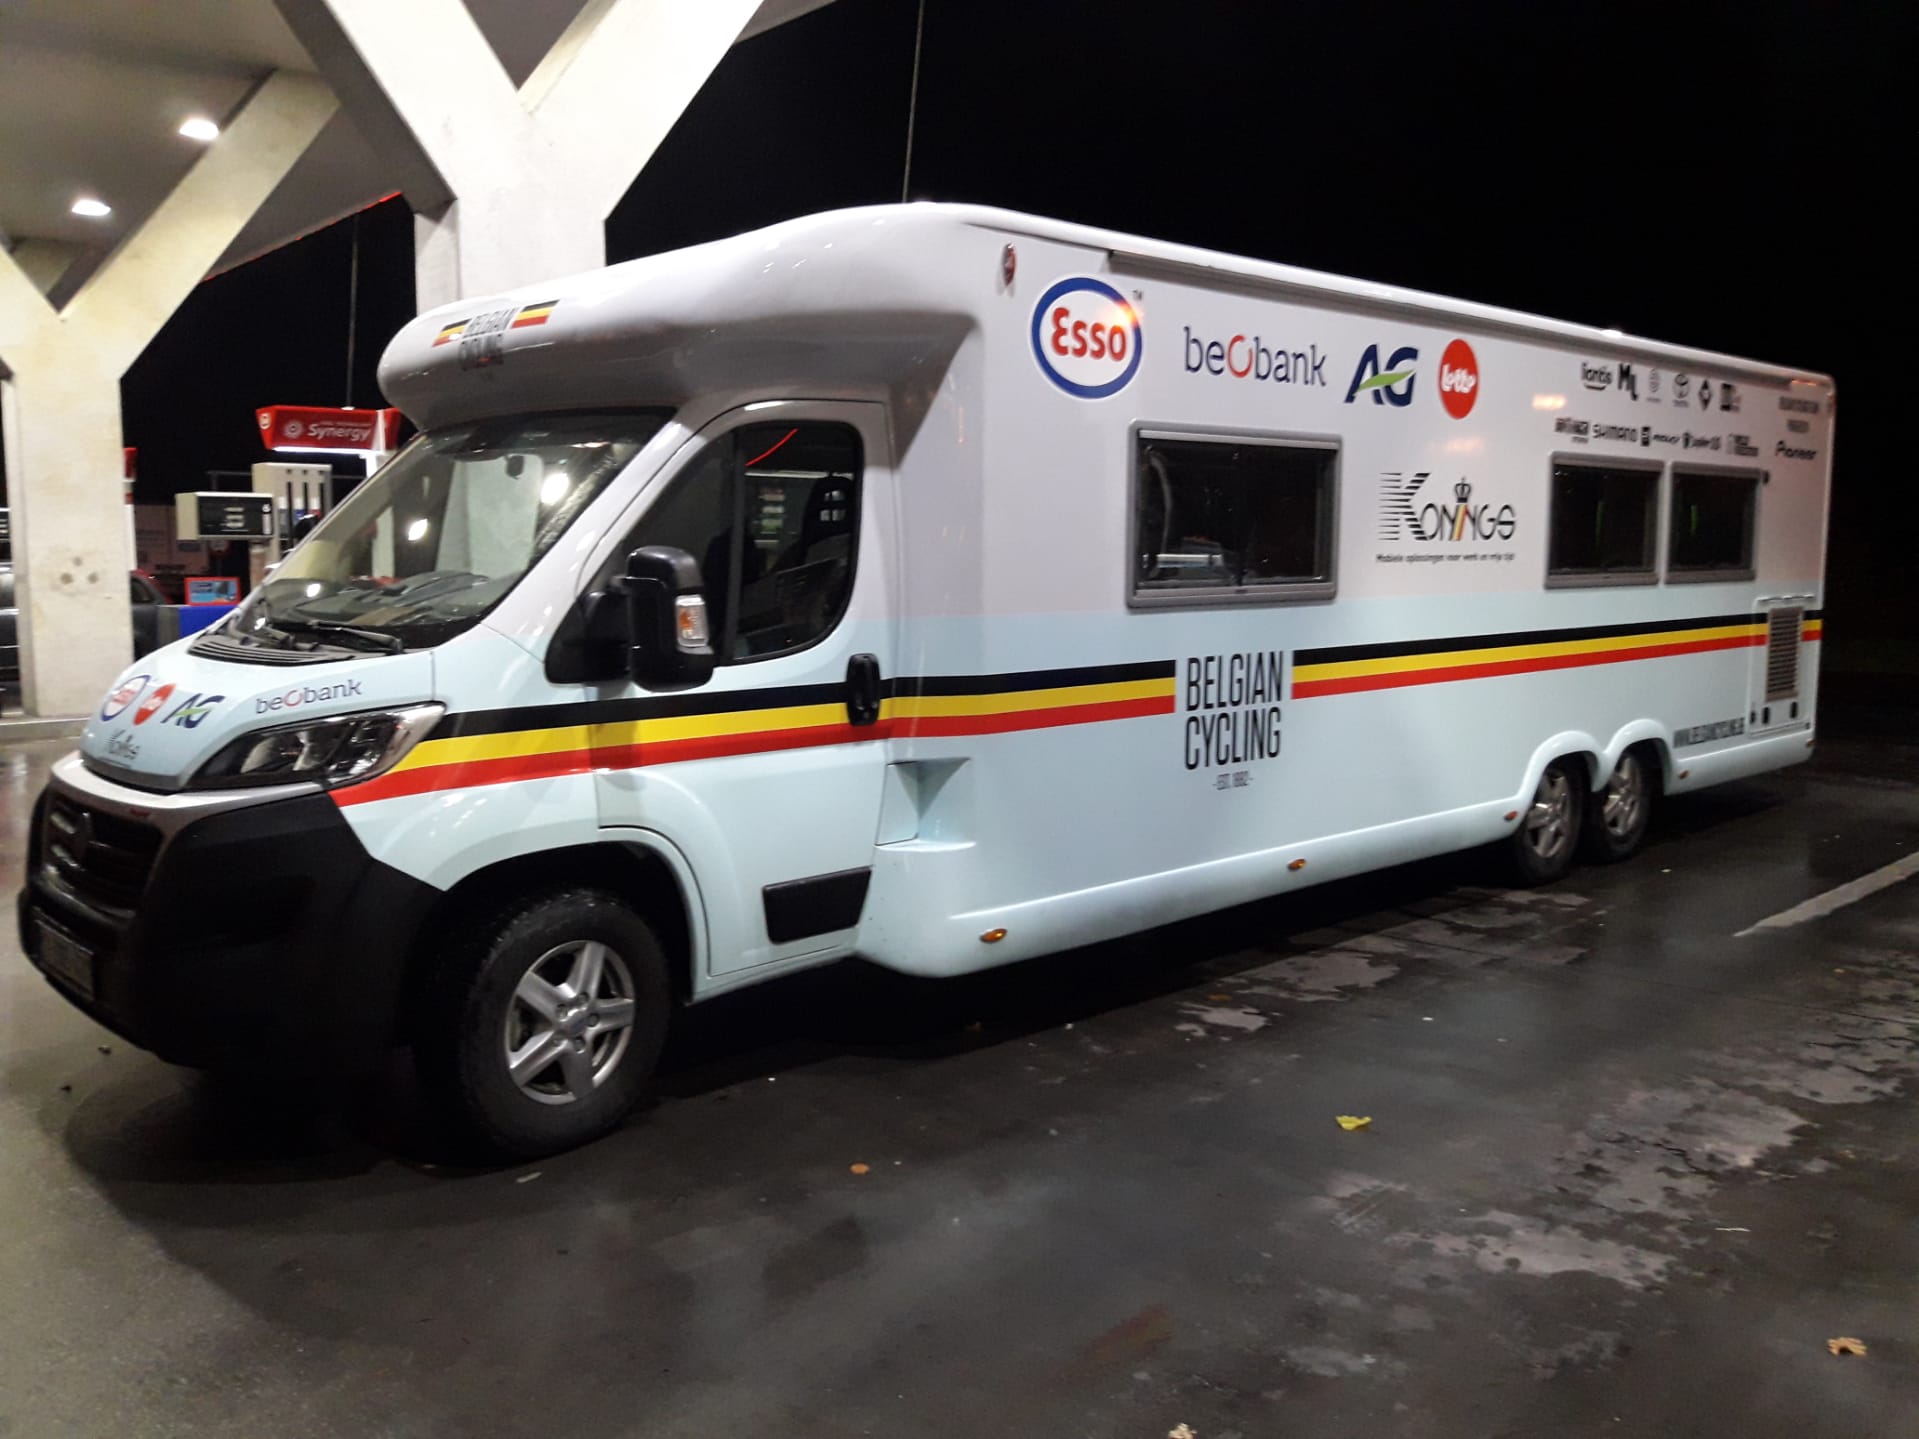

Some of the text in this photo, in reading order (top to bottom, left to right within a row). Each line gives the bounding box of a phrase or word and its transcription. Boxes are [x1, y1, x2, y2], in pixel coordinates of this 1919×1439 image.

[1051, 306, 1128, 362] Esso
[1344, 343, 1419, 407] AG
[308, 423, 372, 442] Synergy
[1186, 651, 1283, 711] BELGIAN
[1185, 706, 1281, 770] CYCLING
